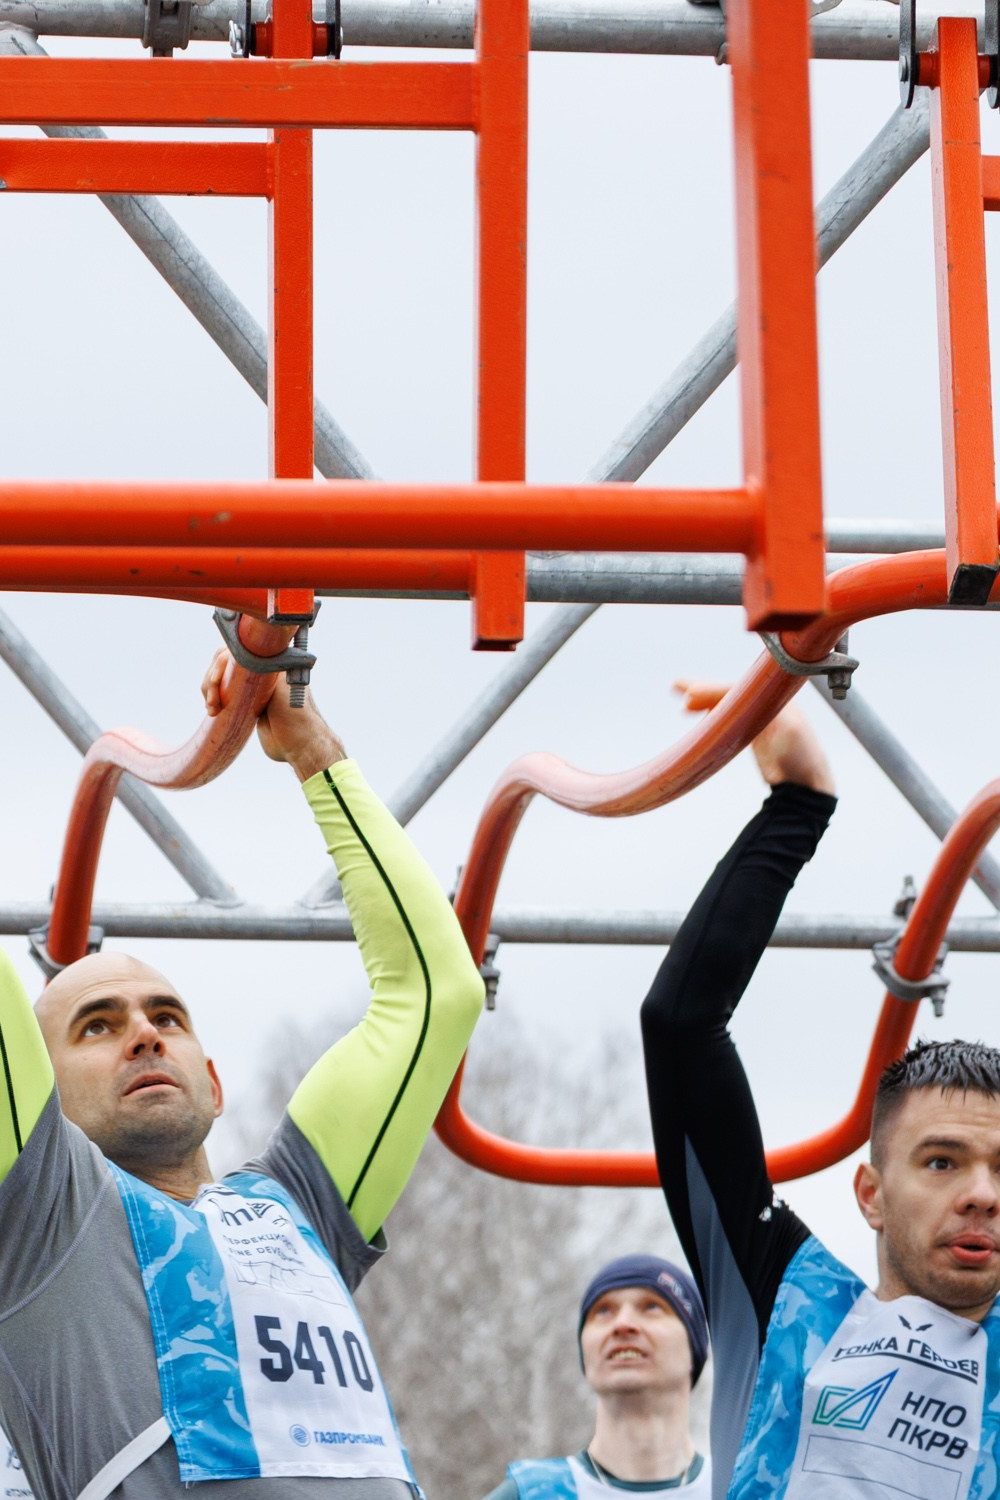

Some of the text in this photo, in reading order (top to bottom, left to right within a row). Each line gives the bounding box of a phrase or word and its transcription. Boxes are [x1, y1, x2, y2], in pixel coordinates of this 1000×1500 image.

[254, 1315, 374, 1393] 5410
[834, 1336, 979, 1378] ГОНКА ГЕРОЕВ
[900, 1391, 968, 1428] НПО
[313, 1430, 386, 1447] ГАЗПРОМБАНК
[887, 1418, 969, 1460] ПКРВ
